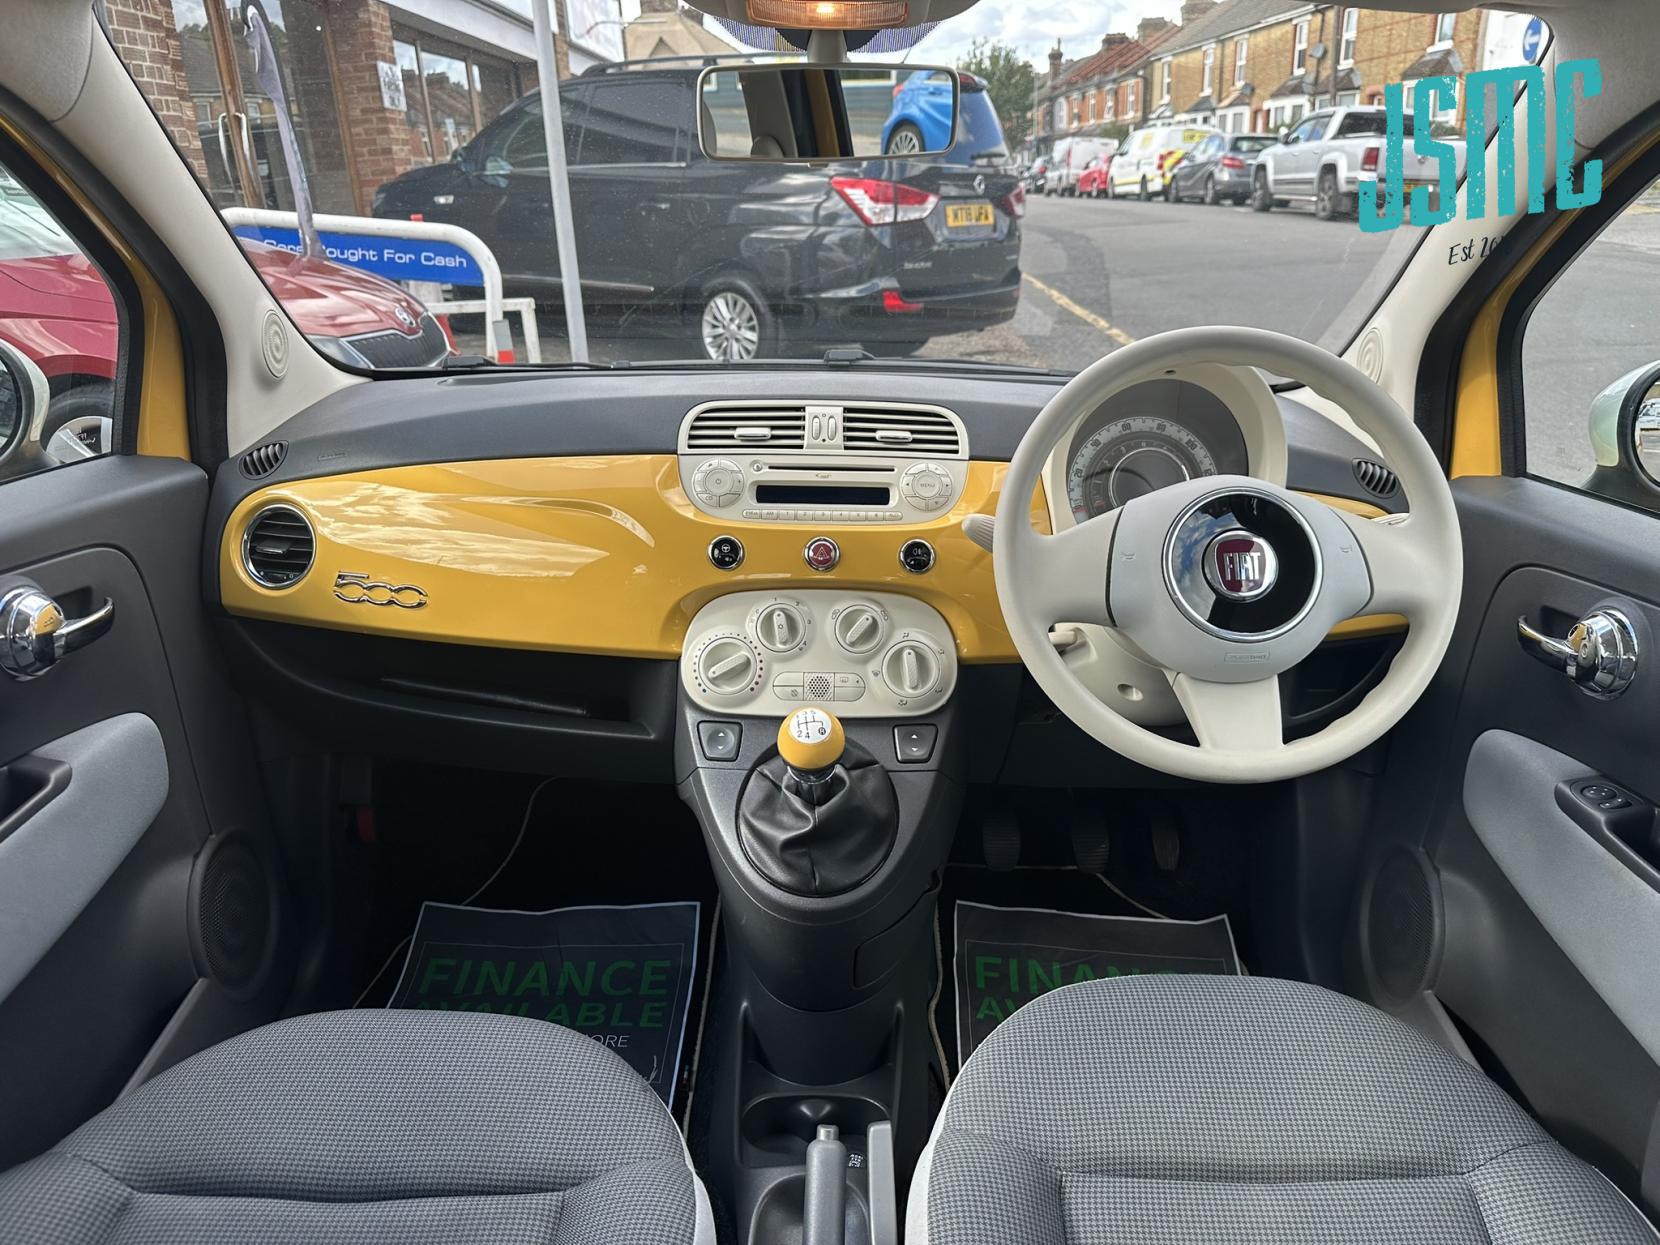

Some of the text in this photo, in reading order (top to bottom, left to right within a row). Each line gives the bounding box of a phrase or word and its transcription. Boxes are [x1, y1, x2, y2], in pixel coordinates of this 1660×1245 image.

[321, 245, 378, 262] ought
[383, 248, 416, 264] For
[420, 252, 468, 268] Cash
[1223, 551, 1261, 581] FIAT
[333, 570, 428, 609] 500
[796, 729, 803, 738] 2
[804, 731, 811, 740] 4
[416, 956, 673, 998] FINANCE
[975, 955, 1178, 994] FINA
